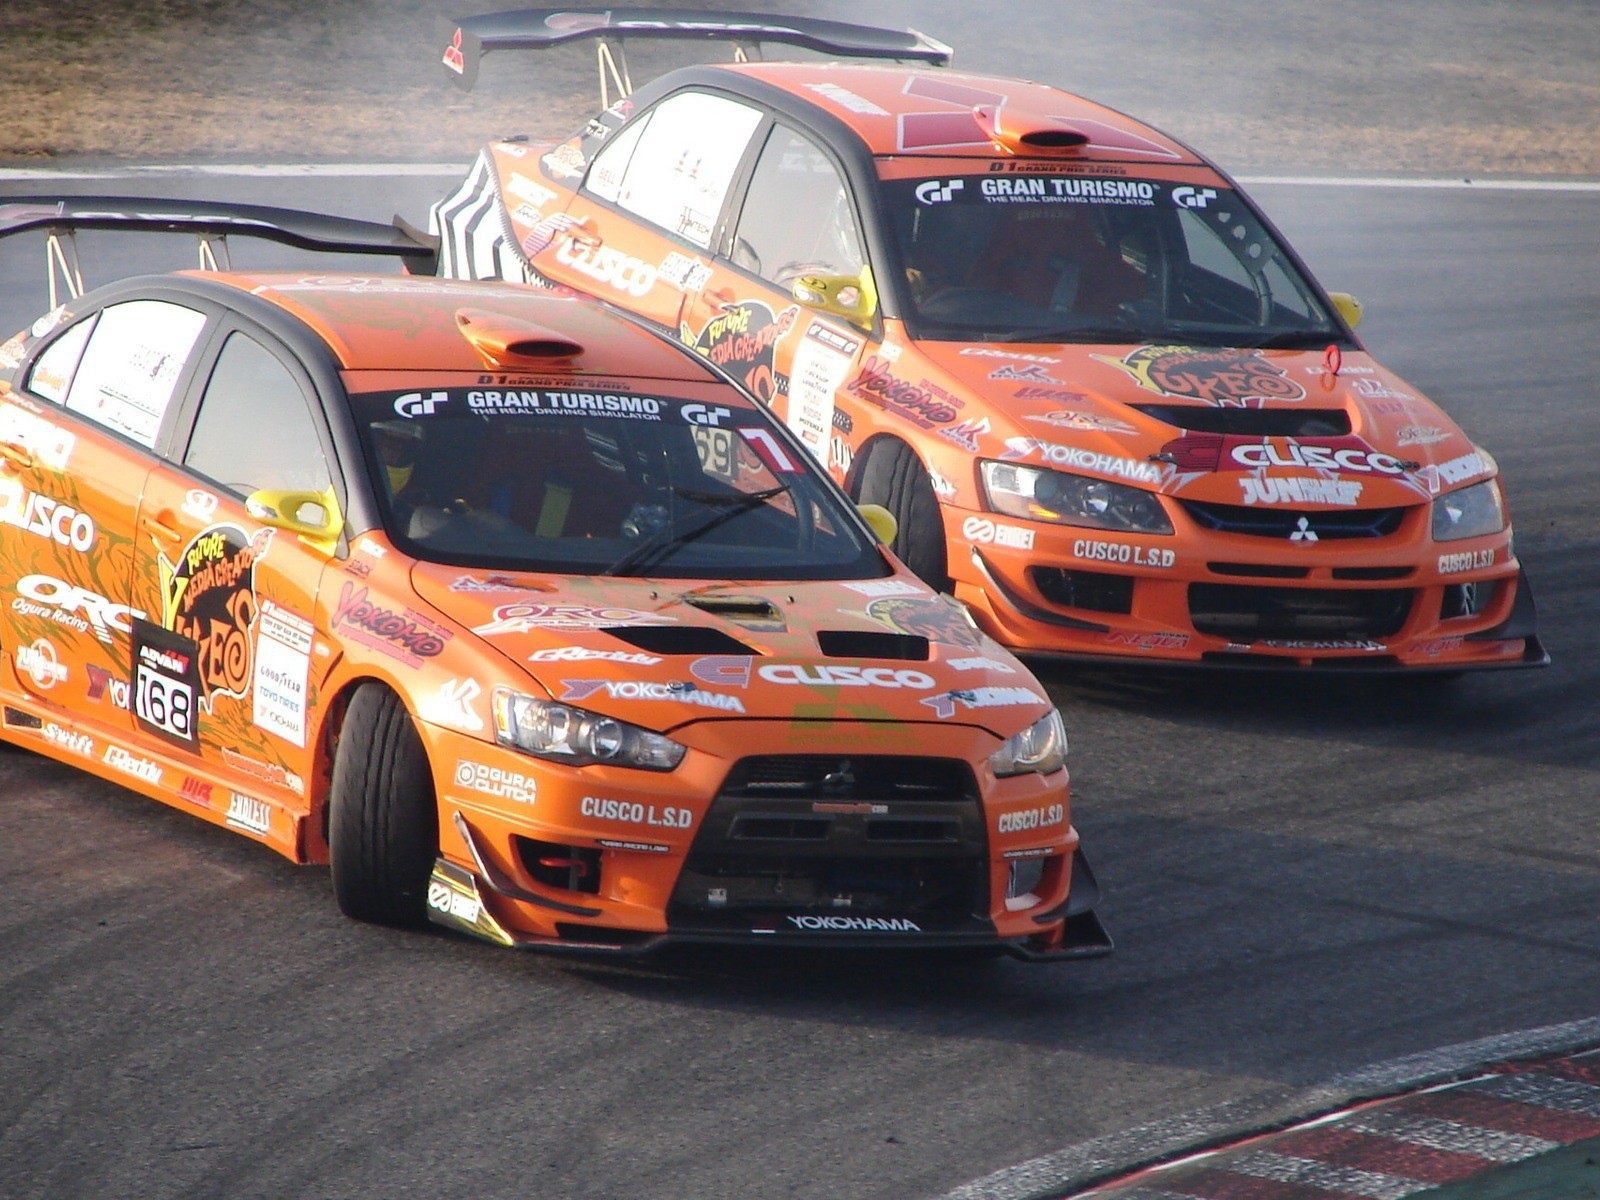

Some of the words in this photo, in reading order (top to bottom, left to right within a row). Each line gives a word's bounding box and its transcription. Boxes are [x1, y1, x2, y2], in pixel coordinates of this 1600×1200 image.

[981, 178, 1048, 196] GRAN
[1050, 179, 1154, 199] TURISMO
[1009, 196, 1039, 204] REAL
[1041, 196, 1090, 204] DRIVING
[1090, 196, 1156, 207] SIMULATOR
[556, 239, 658, 297] CUSCO
[467, 391, 543, 408] GRAN
[545, 392, 660, 414] TURISMO
[847, 355, 956, 423] YOKOMO
[501, 408, 534, 416] REAL
[537, 409, 587, 417] DRIVING
[589, 410, 662, 422] SIMULATOR
[1040, 440, 1162, 485] YOKOHAMA
[1231, 443, 1405, 474] CUSCO
[187, 531, 227, 576] FUTURE
[1073, 539, 1131, 563] CUSCO
[1133, 546, 1176, 568] L.S.D
[1438, 555, 1473, 574] CUSCO
[1473, 549, 1495, 568] L.S.D
[12, 598, 52, 619] Ogura
[52, 609, 89, 633] Racing
[332, 581, 445, 657] YOKOMO
[140, 645, 185, 675] ADVAN
[758, 664, 936, 690] CUSCO
[139, 673, 190, 736] 168
[474, 777, 537, 805] CLUTCH
[475, 764, 538, 792] OGURA
[580, 796, 644, 823] CUSCO
[647, 804, 693, 828] L.S.D
[998, 808, 1039, 833] CUSCO
[1039, 803, 1063, 827] L.S.D
[786, 915, 921, 932] YOKOHAMA
